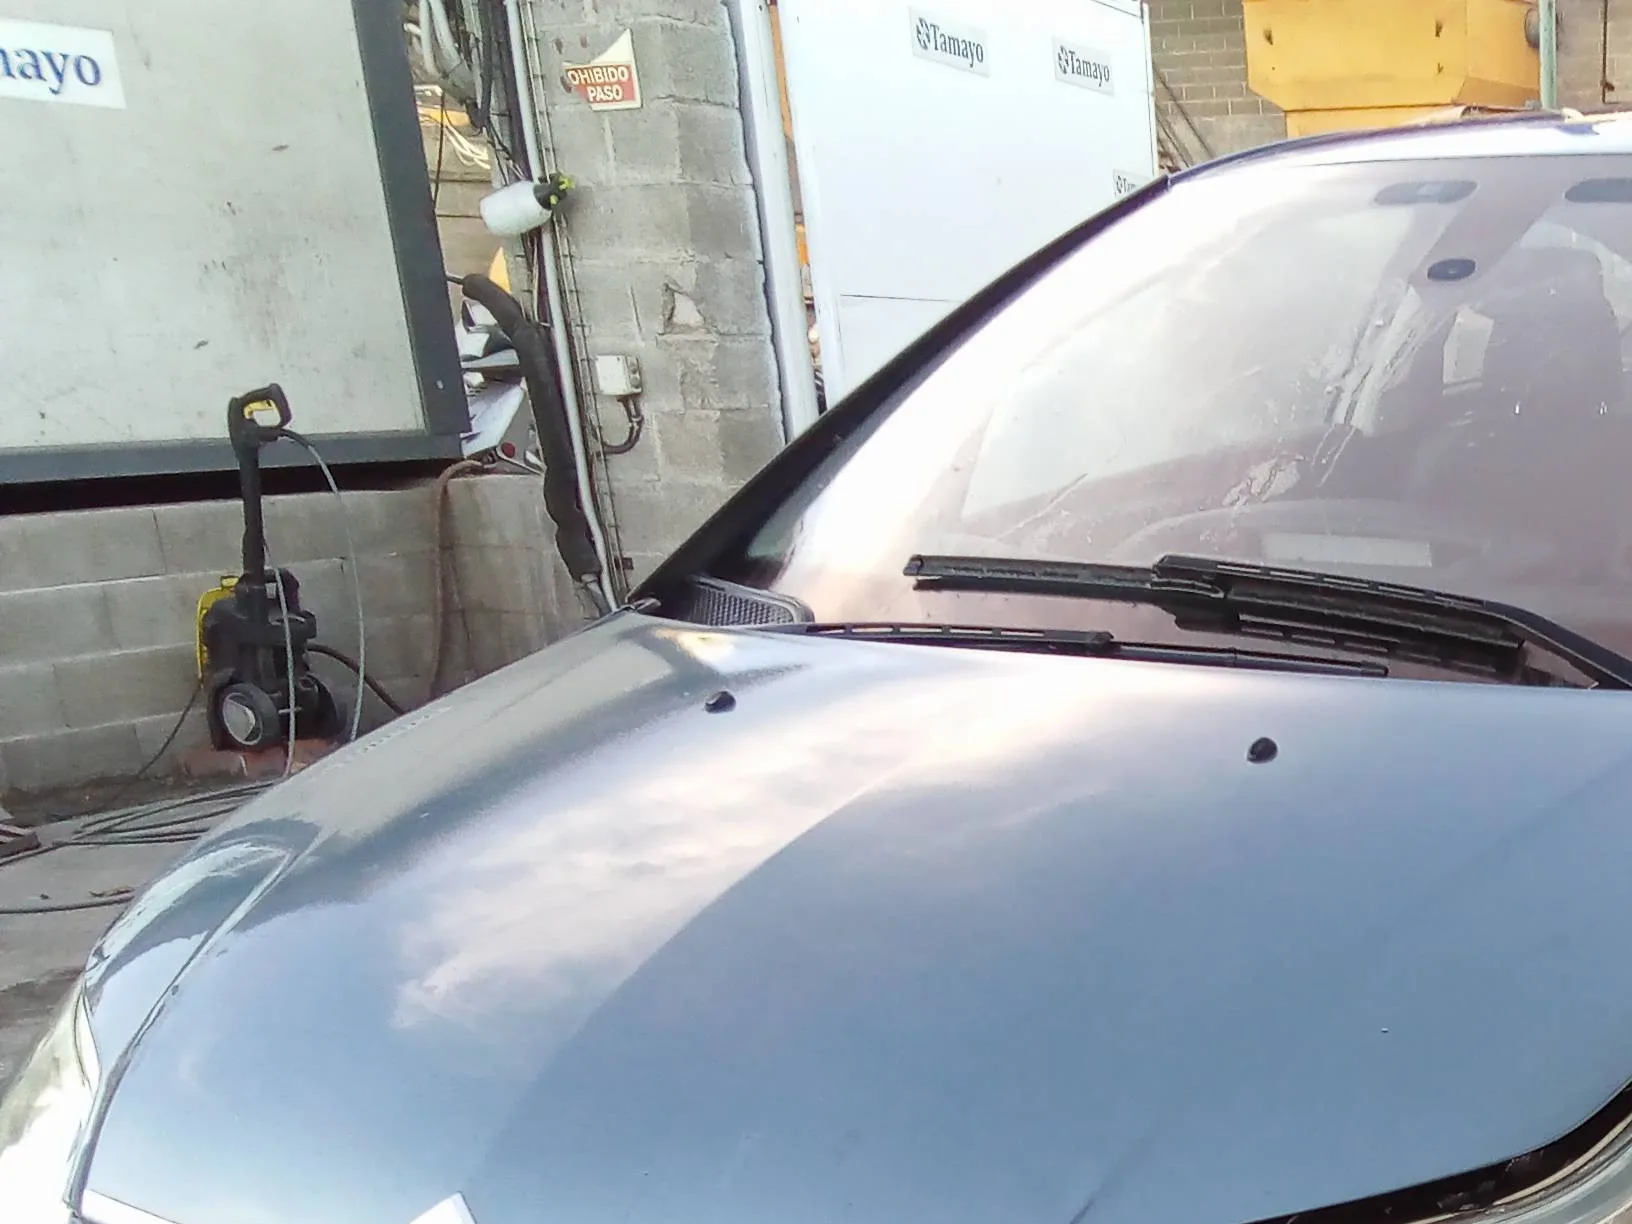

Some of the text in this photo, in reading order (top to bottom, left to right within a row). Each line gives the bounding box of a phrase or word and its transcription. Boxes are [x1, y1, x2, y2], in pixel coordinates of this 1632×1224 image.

[930, 24, 984, 68] Tamayo
[1068, 50, 1110, 87] Tamayo
[586, 84, 623, 102] PASO
